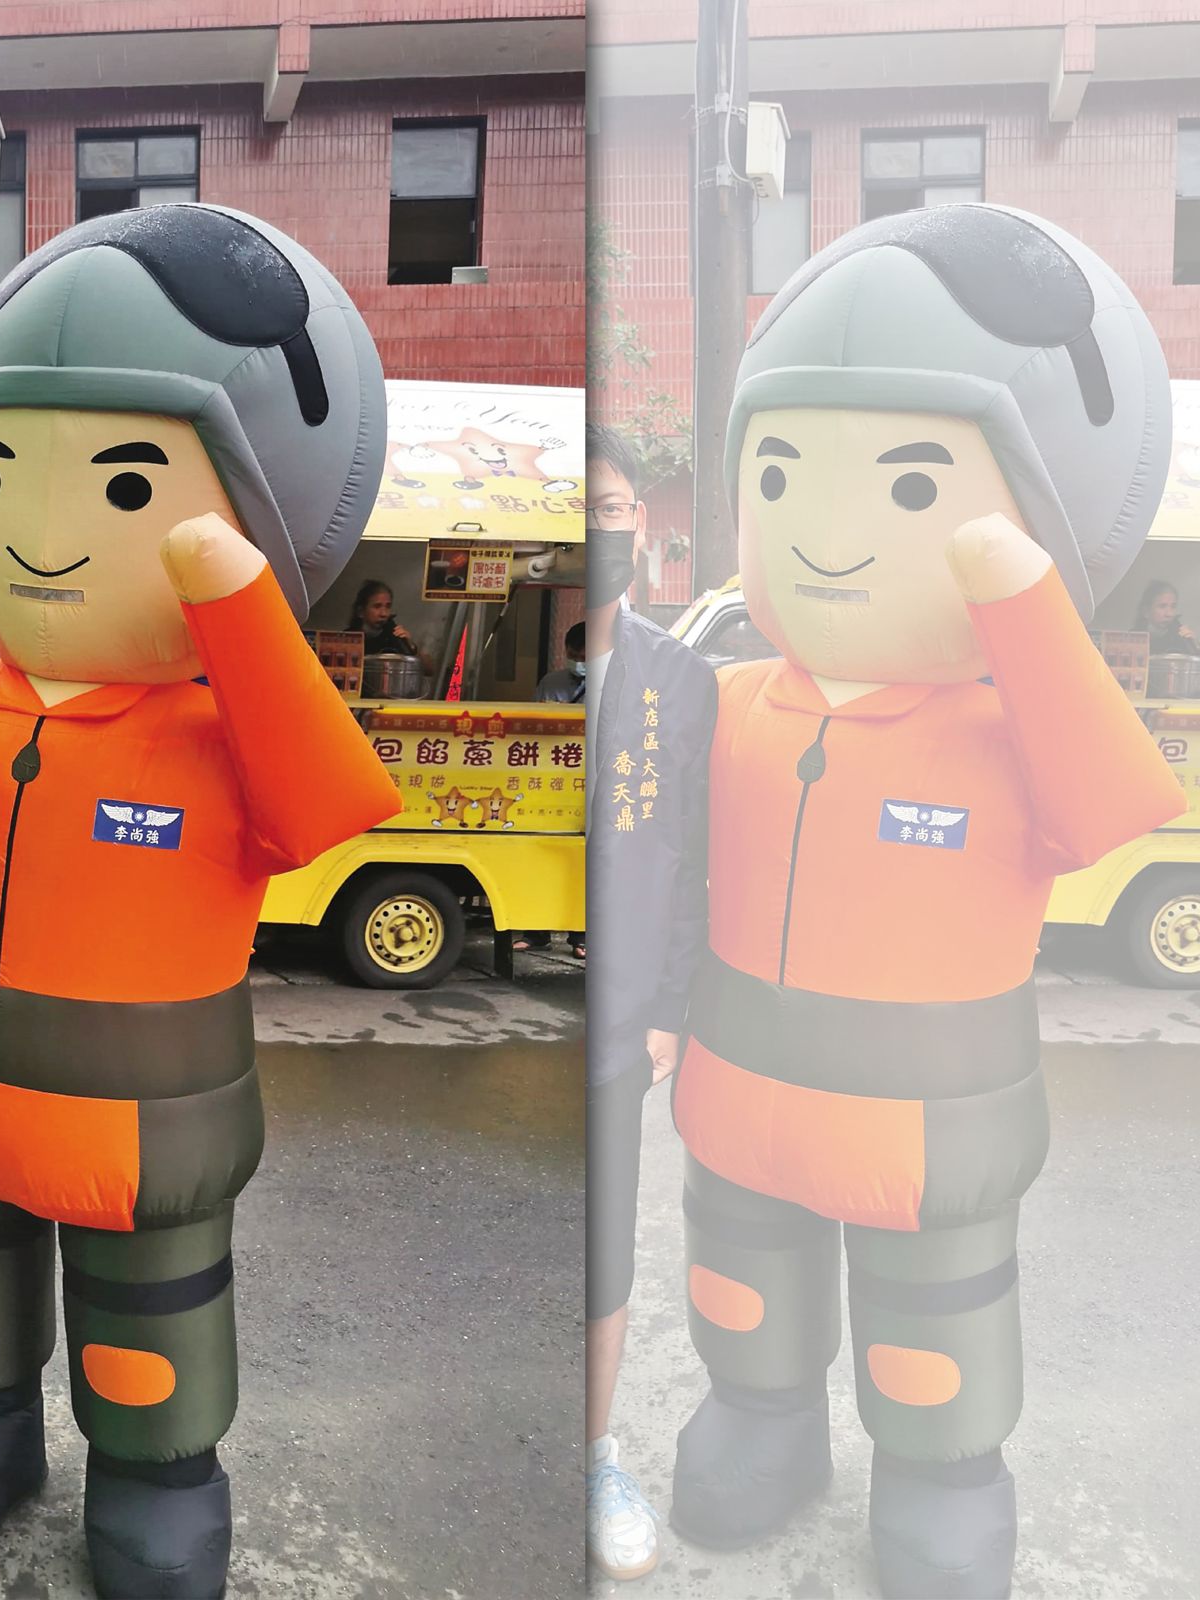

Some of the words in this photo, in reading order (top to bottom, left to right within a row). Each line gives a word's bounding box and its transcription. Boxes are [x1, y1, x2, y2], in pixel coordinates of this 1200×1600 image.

[640, 688, 661, 819] 新店區大鵬里
[613, 750, 637, 832] 喬天鼎
[114, 825, 159, 844] 李尚強
[899, 825, 944, 844] 李尚強
